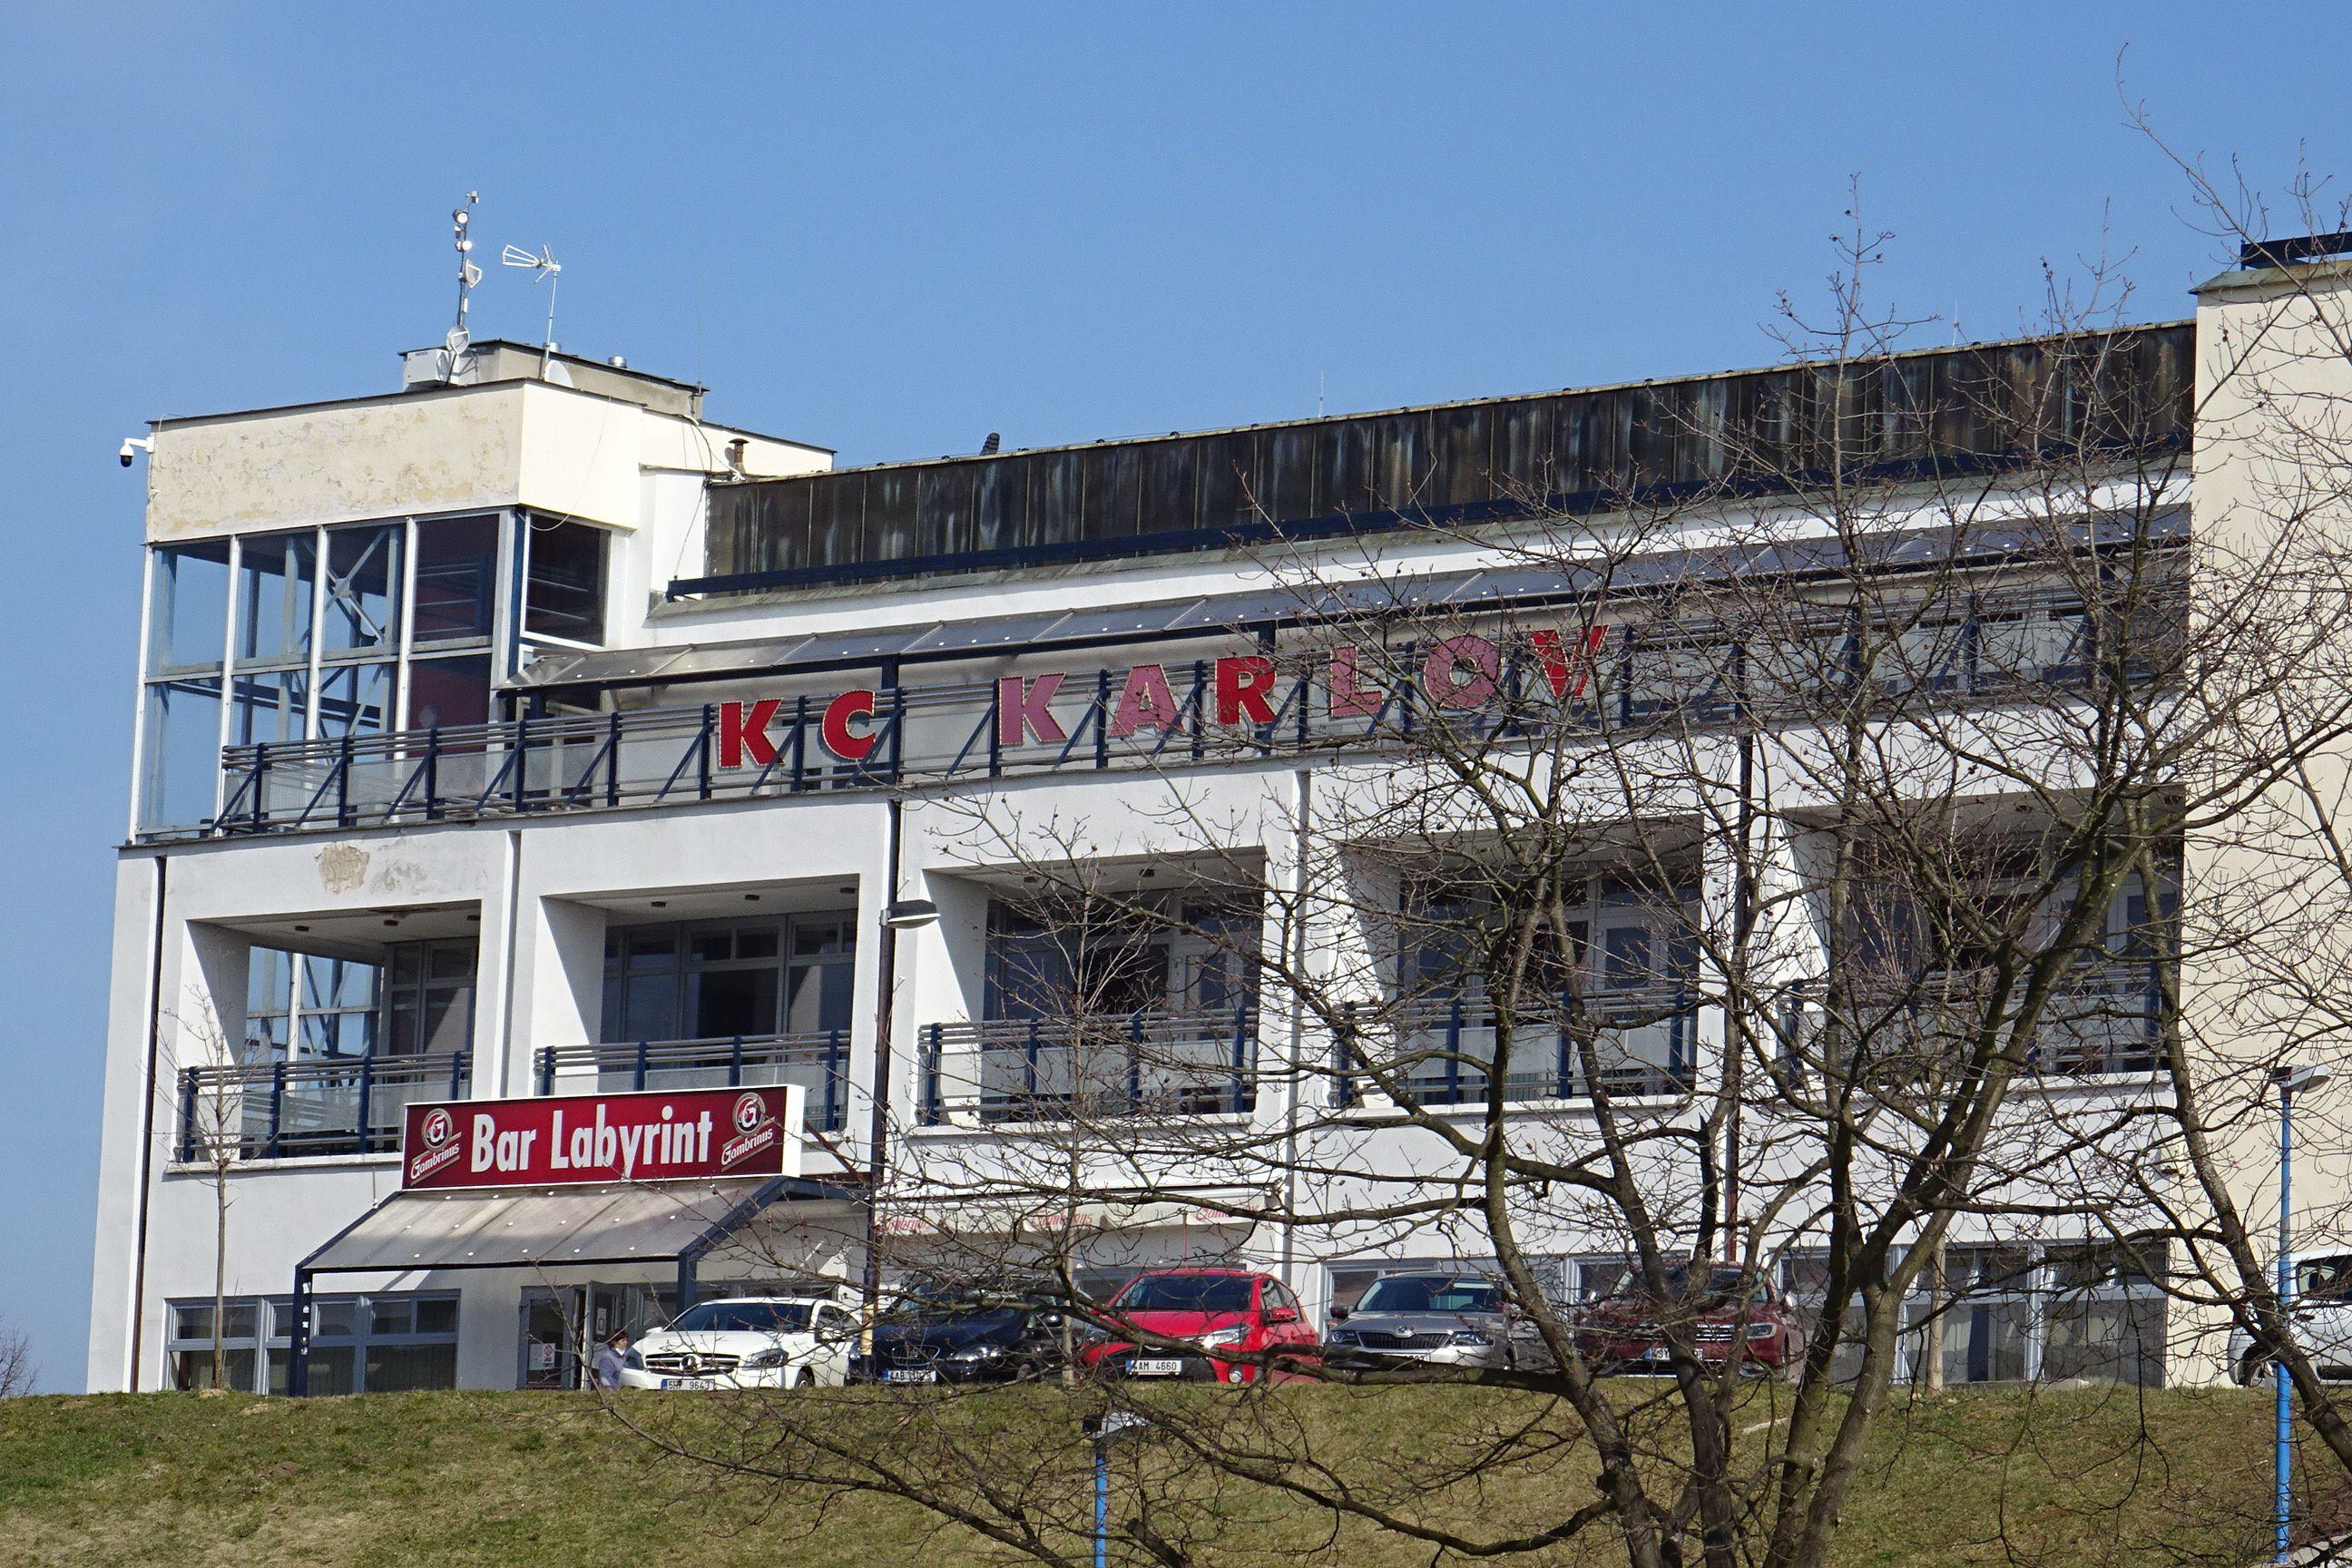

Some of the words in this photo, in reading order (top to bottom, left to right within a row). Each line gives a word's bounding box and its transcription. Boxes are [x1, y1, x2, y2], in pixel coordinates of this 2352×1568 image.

[718, 689, 877, 768] KC
[998, 623, 1611, 746] KARLOV
[470, 1113, 537, 1173] Bar
[550, 1103, 713, 1181] Labyrint
[720, 1128, 773, 1166] Gambrinus
[410, 1143, 461, 1180] Gambrinus
[1155, 1361, 1178, 1371] 4660
[689, 1380, 710, 1390] 9643
